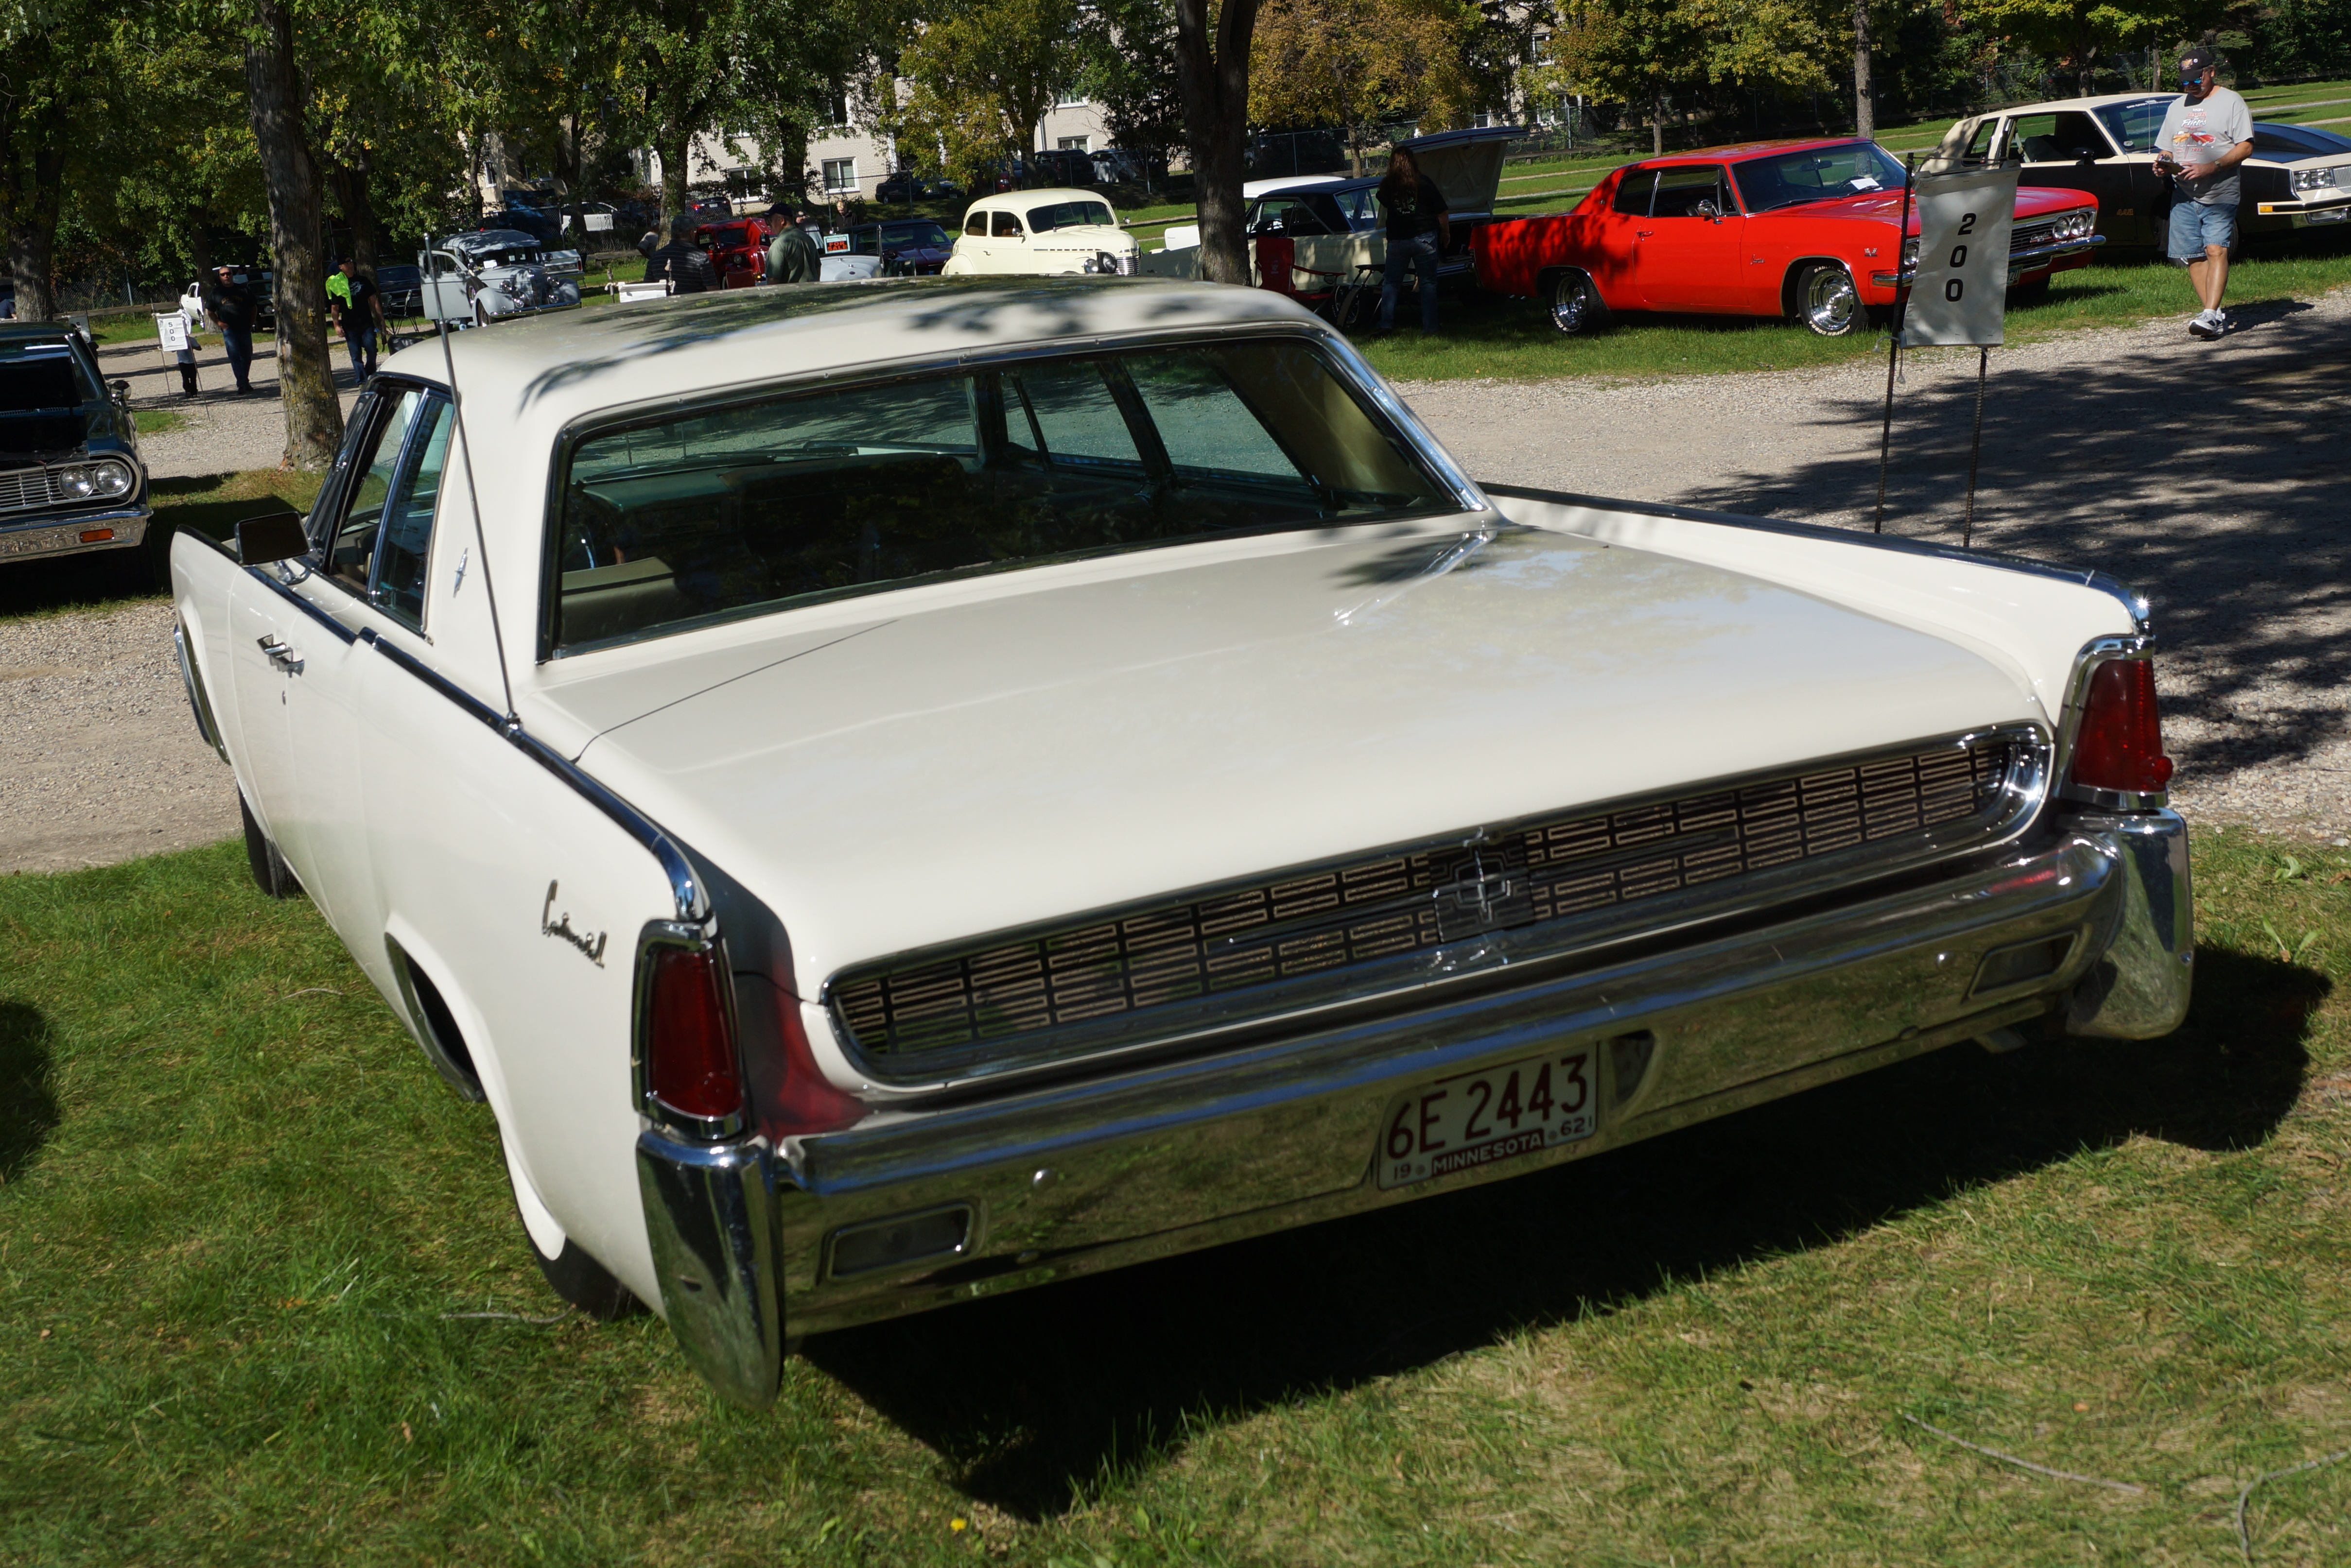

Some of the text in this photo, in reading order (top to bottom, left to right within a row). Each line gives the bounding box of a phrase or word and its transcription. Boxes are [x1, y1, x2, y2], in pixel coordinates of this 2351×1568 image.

[1945, 212, 1977, 302] 200
[168, 322, 176, 342] 500
[1808, 320, 1850, 336] COOPER COBRA
[1387, 1052, 1588, 1160] 6E 2443
[1393, 1162, 1411, 1180] 19
[1432, 1132, 1542, 1176] MINNESOTA
